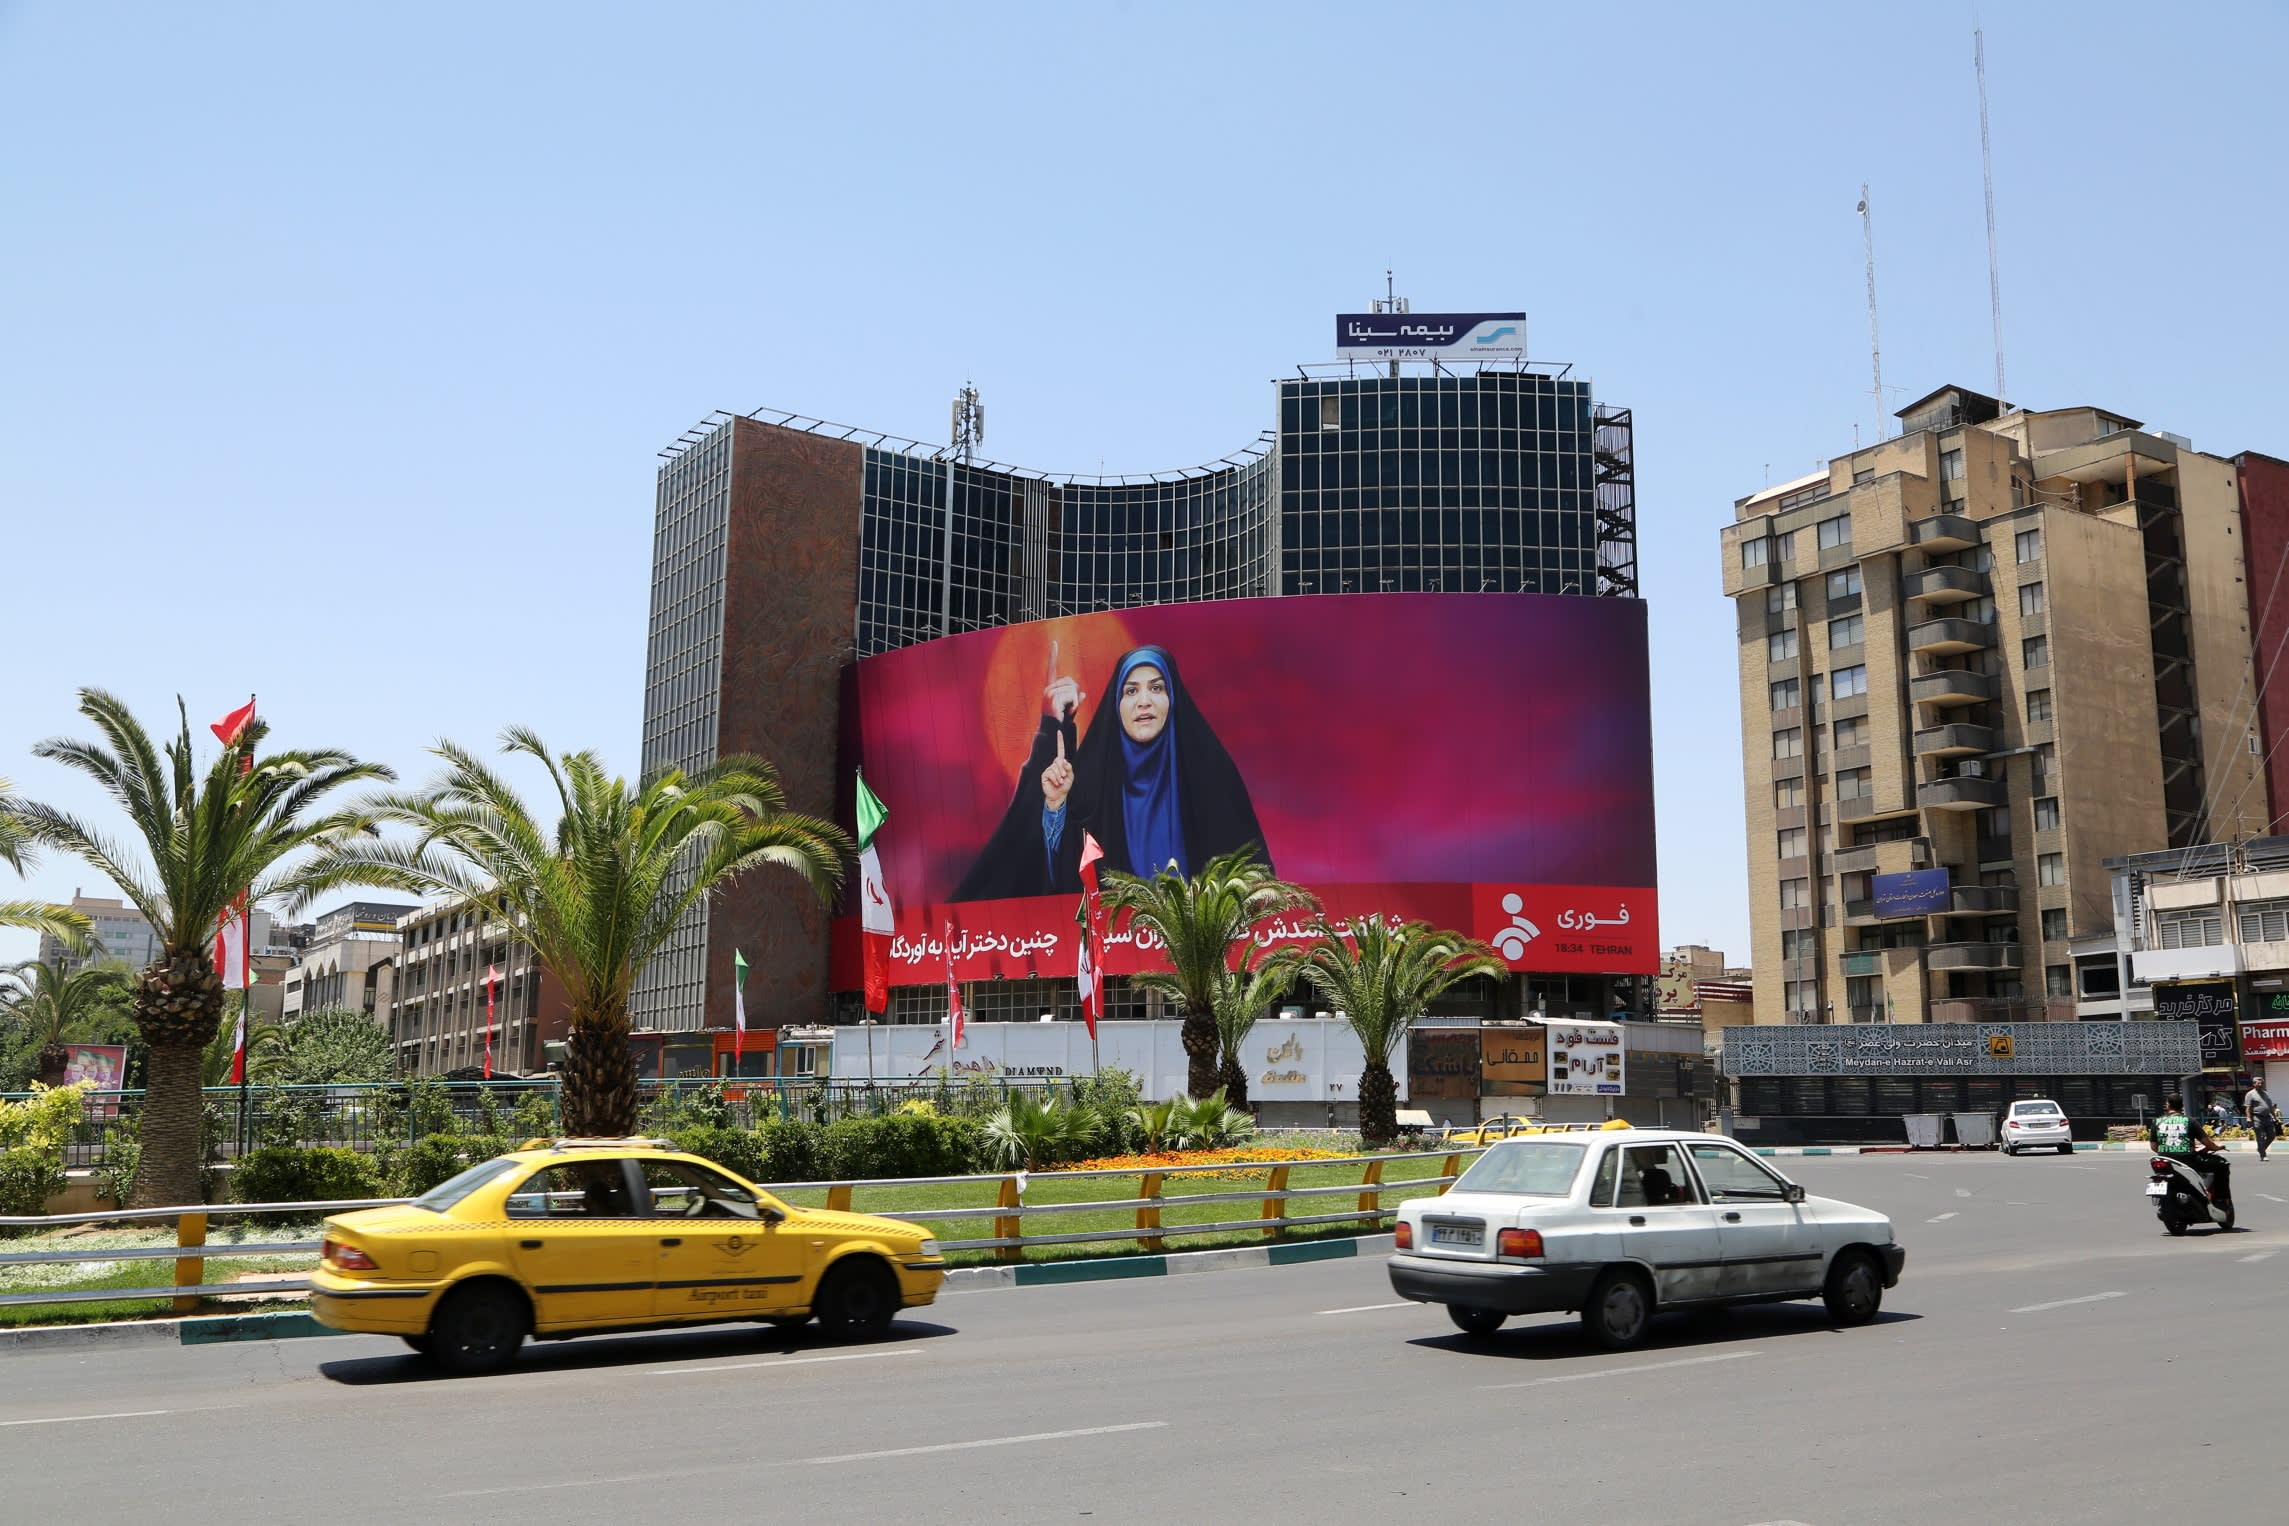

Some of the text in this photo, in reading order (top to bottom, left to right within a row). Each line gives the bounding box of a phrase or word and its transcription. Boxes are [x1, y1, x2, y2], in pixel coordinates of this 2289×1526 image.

[1348, 322, 1454, 341] بیمه سینا
[1557, 903, 1630, 931] فوری
[927, 939, 943, 961] به
[966, 930, 1008, 960] دختر
[1009, 931, 1058, 957] چنین
[1590, 944, 1633, 955] TEHRAN
[1556, 1029, 1619, 1048] فست فود
[1571, 1057, 1605, 1075] آرام
[1845, 1058, 1974, 1067] Meydan-e Hazrat-e Vali Asr
[688, 1285, 769, 1305] Airport taxi
